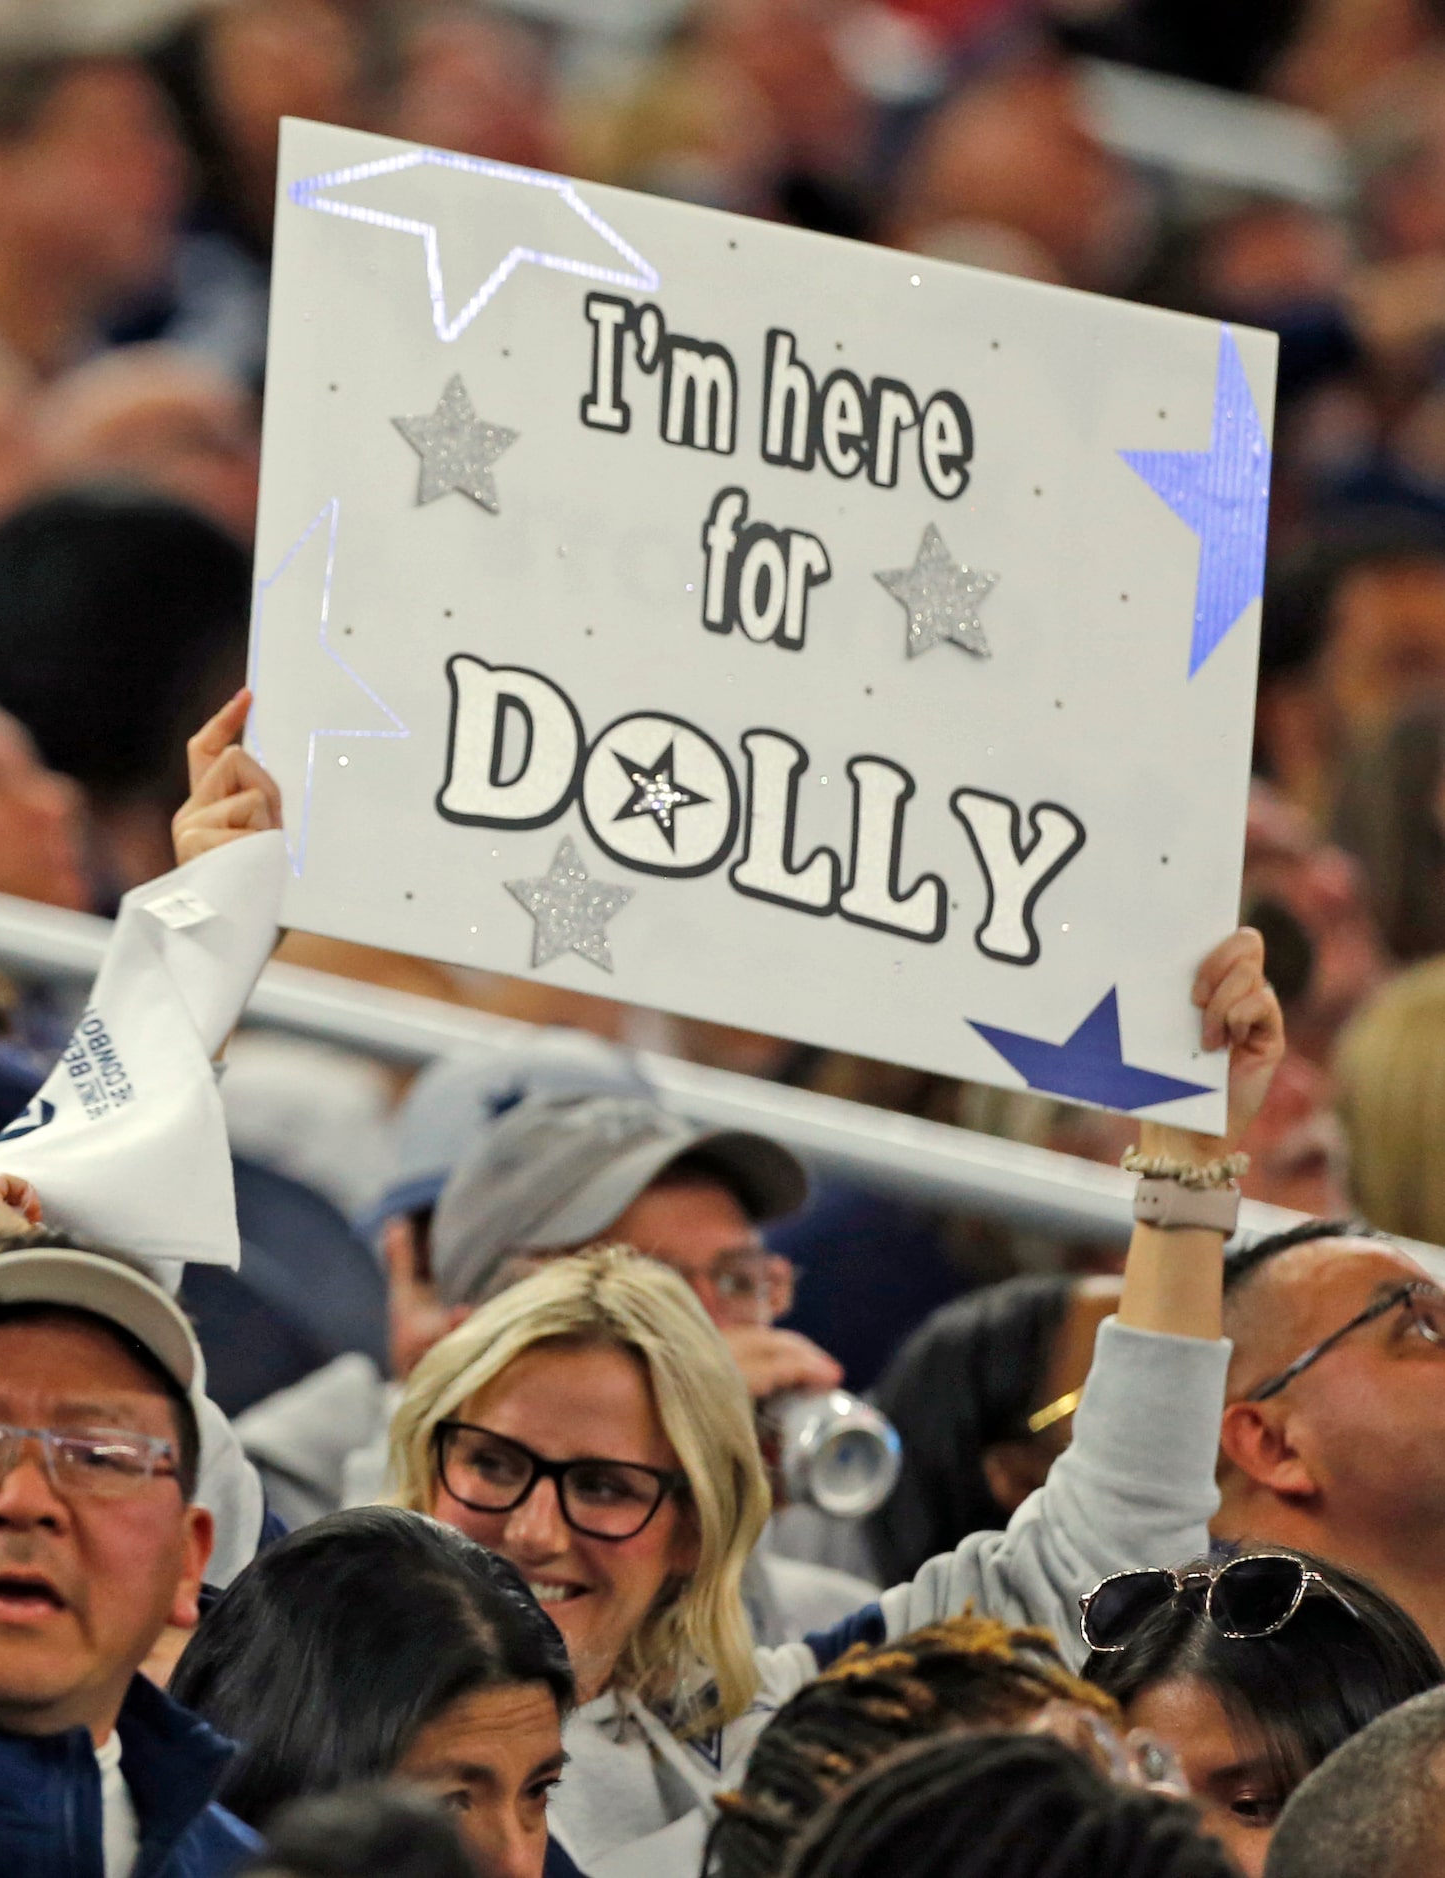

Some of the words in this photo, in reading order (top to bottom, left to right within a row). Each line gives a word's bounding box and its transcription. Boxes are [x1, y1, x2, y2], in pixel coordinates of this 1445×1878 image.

[580, 292, 738, 456] I'm
[761, 326, 973, 501] here
[702, 485, 832, 651] for
[435, 653, 1087, 966] DOLLY
